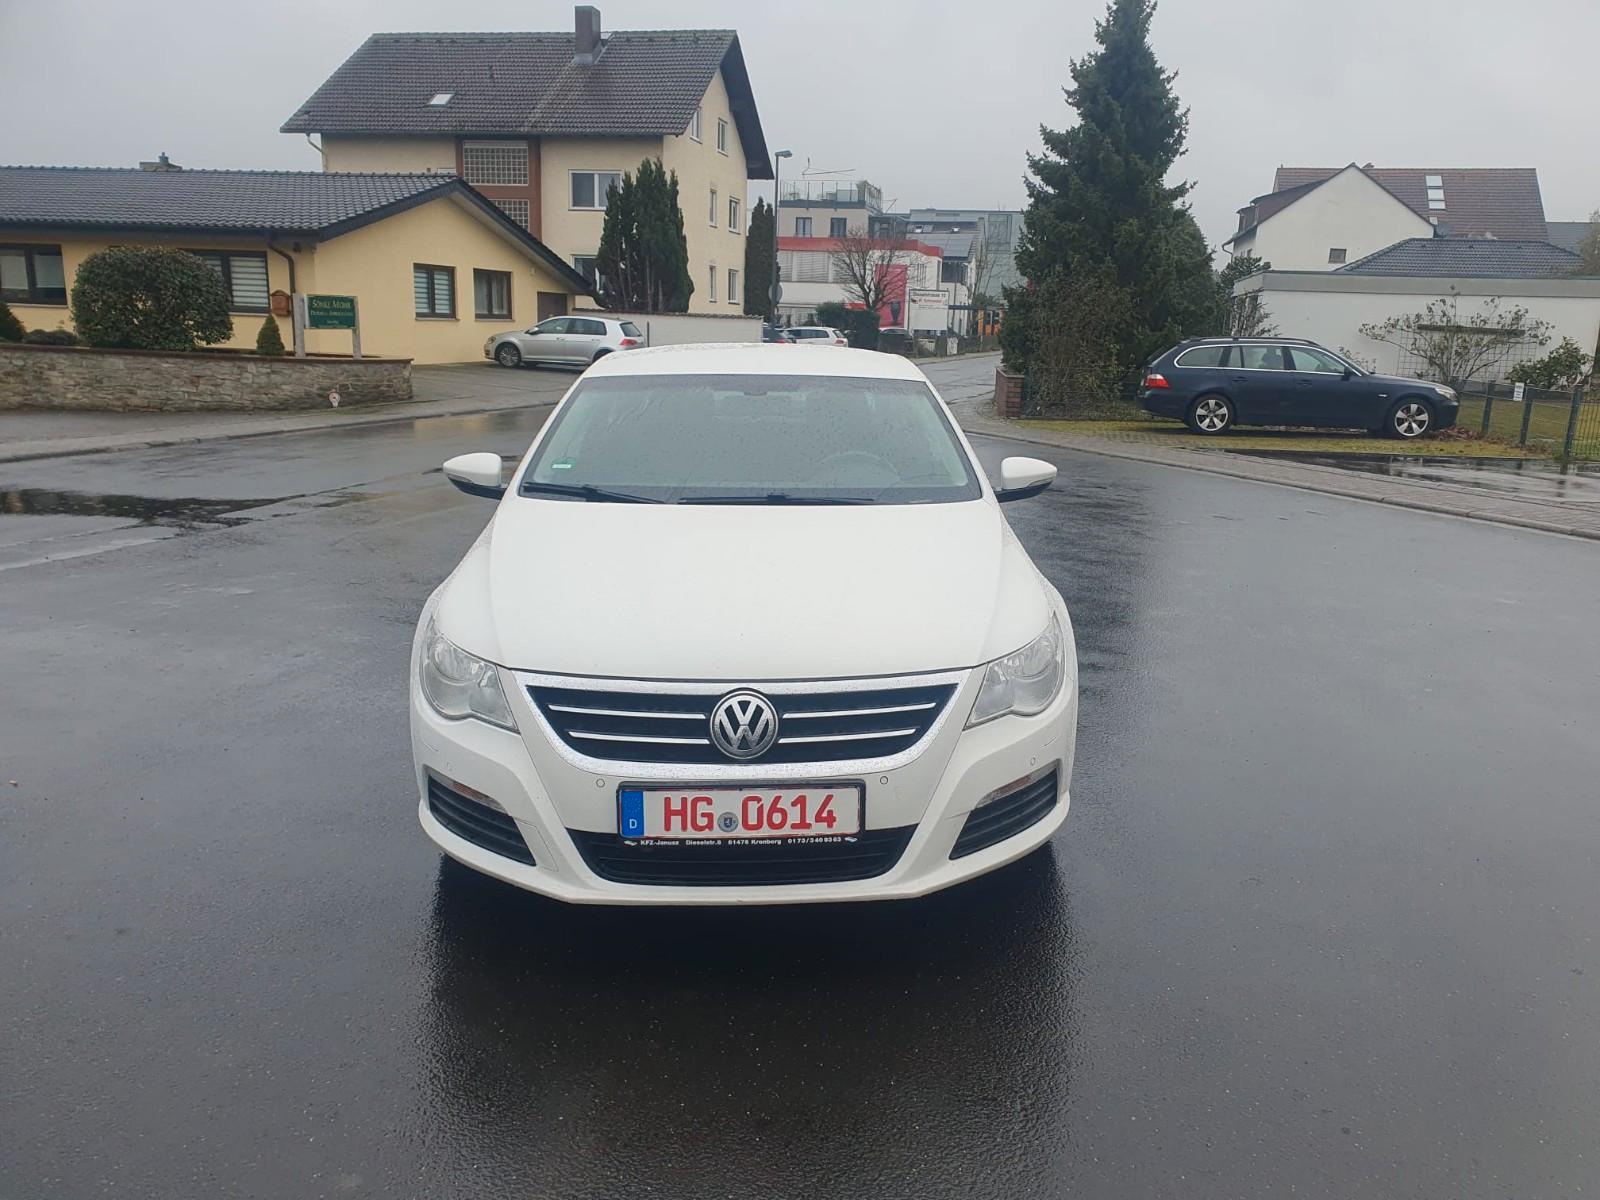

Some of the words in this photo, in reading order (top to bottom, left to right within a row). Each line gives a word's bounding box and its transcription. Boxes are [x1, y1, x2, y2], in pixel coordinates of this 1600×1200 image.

[629, 818, 637, 829] D
[663, 796, 714, 832] HG
[741, 794, 837, 831] 0614
